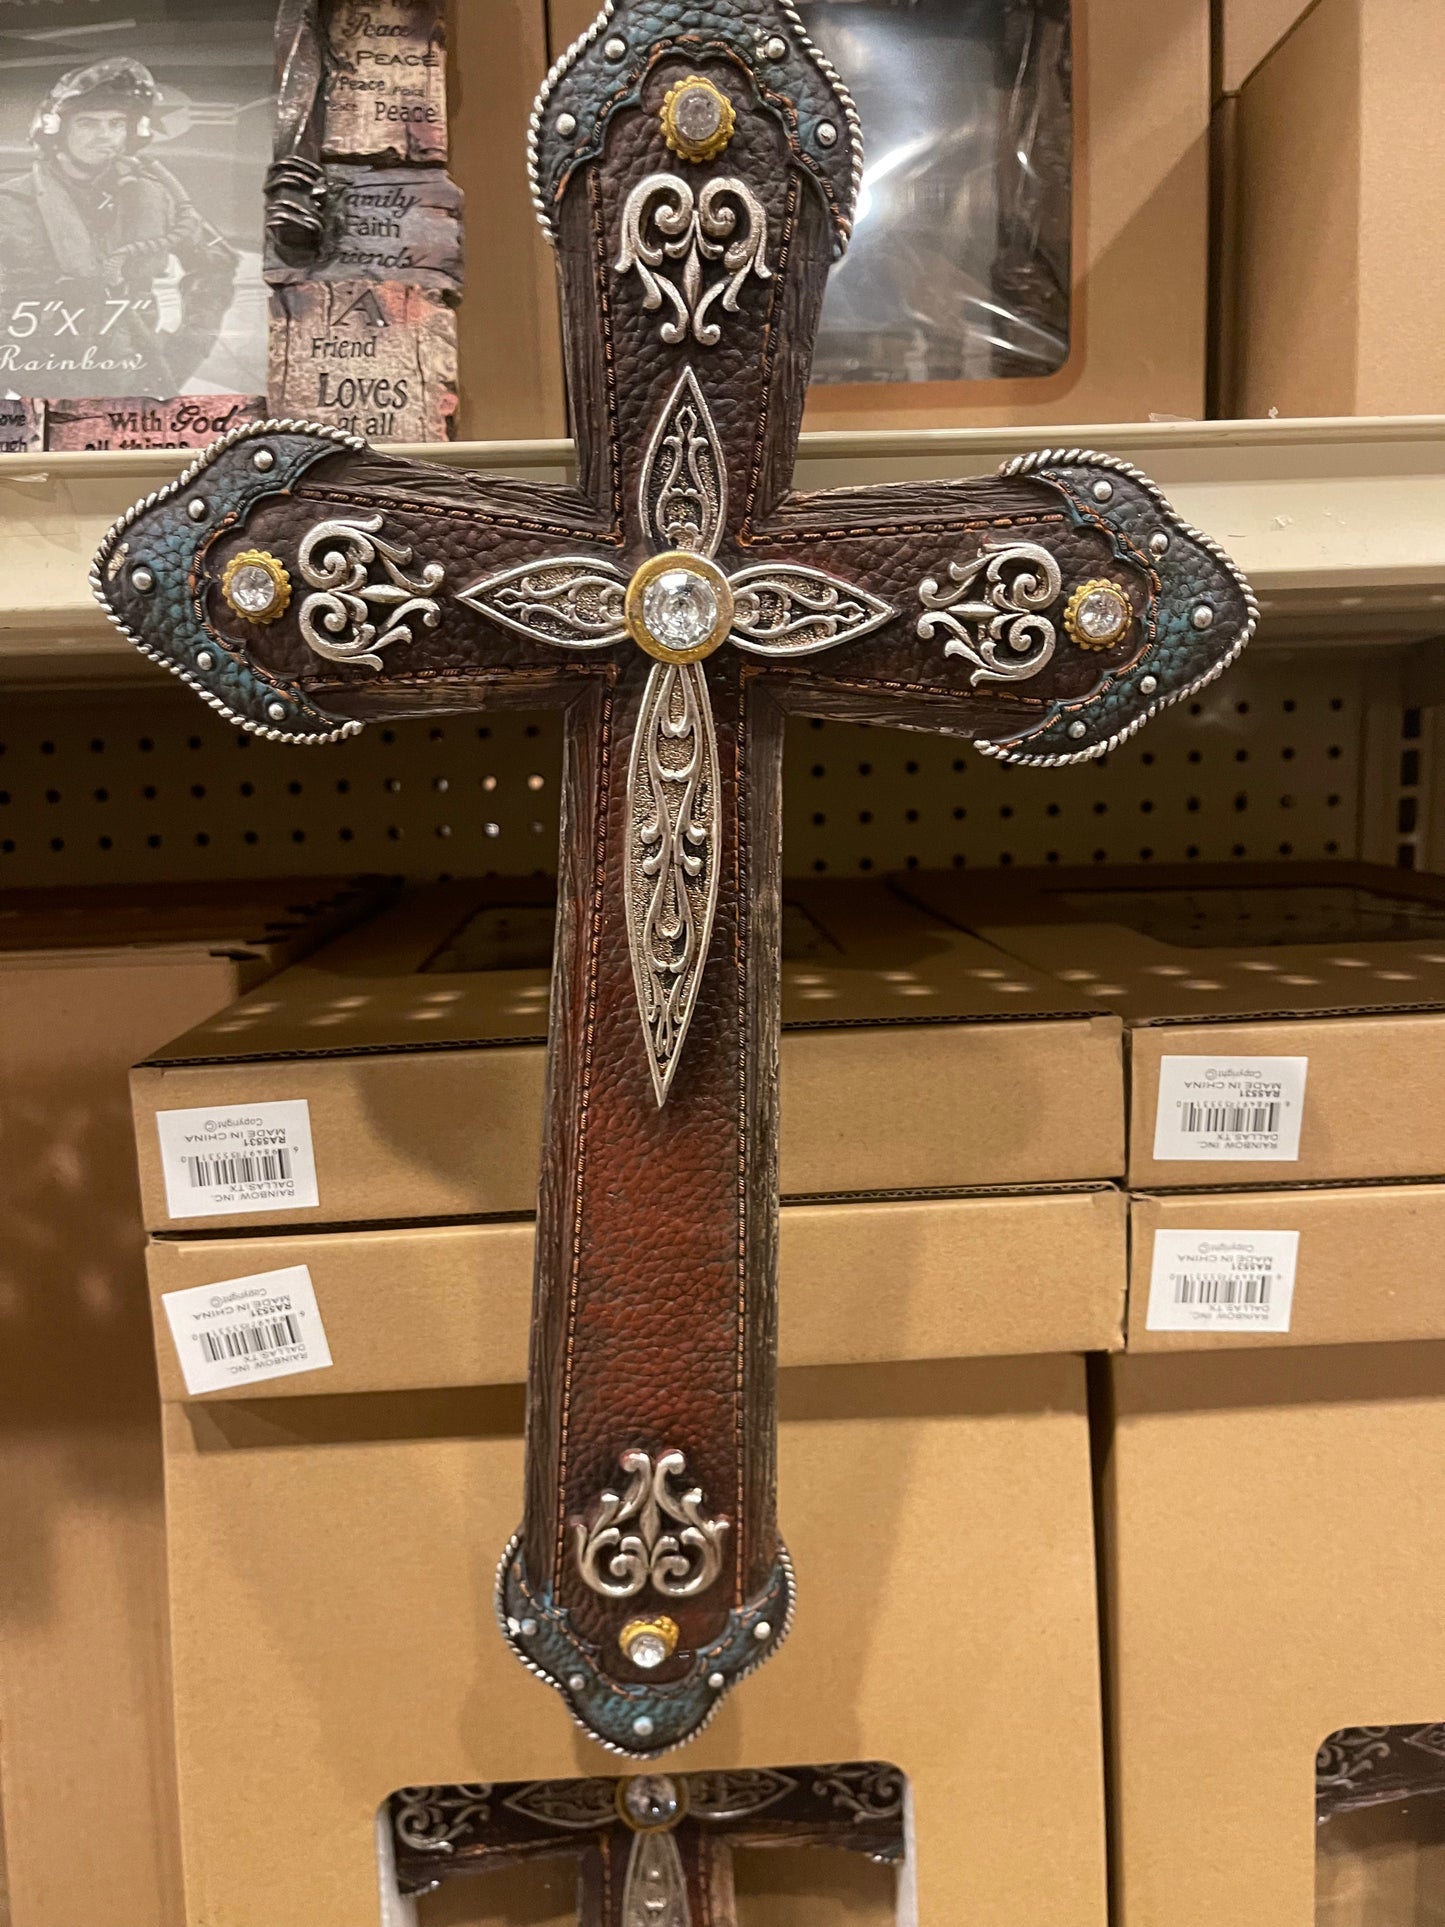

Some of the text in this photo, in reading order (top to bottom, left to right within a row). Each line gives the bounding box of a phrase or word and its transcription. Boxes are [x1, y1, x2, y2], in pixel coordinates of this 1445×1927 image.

[356, 50, 439, 67] PEACE
[340, 76, 385, 91] Peace
[375, 101, 440, 123] Peace
[345, 213, 400, 238] Faith
[331, 288, 390, 327] A
[311, 336, 377, 358] Friend
[0, 345, 148, 371] Rainbow
[108, 403, 239, 433] With God
[338, 413, 394, 436] at all
[1245, 1082, 1282, 1090] MADE
[1240, 1090, 1280, 1098] RA5531
[184, 1132, 228, 1142] CHINA
[247, 1128, 286, 1138] MADE
[244, 1136, 286, 1147] RA5531
[1224, 1141, 1278, 1149] RAINBOW
[240, 1189, 295, 1200] RAINBOW
[1178, 1254, 1218, 1262] CHINA
[192, 1295, 290, 1320] MADE IN CHINA
[250, 1303, 292, 1317] RA5531
[255, 1352, 308, 1368] RAINBOW
